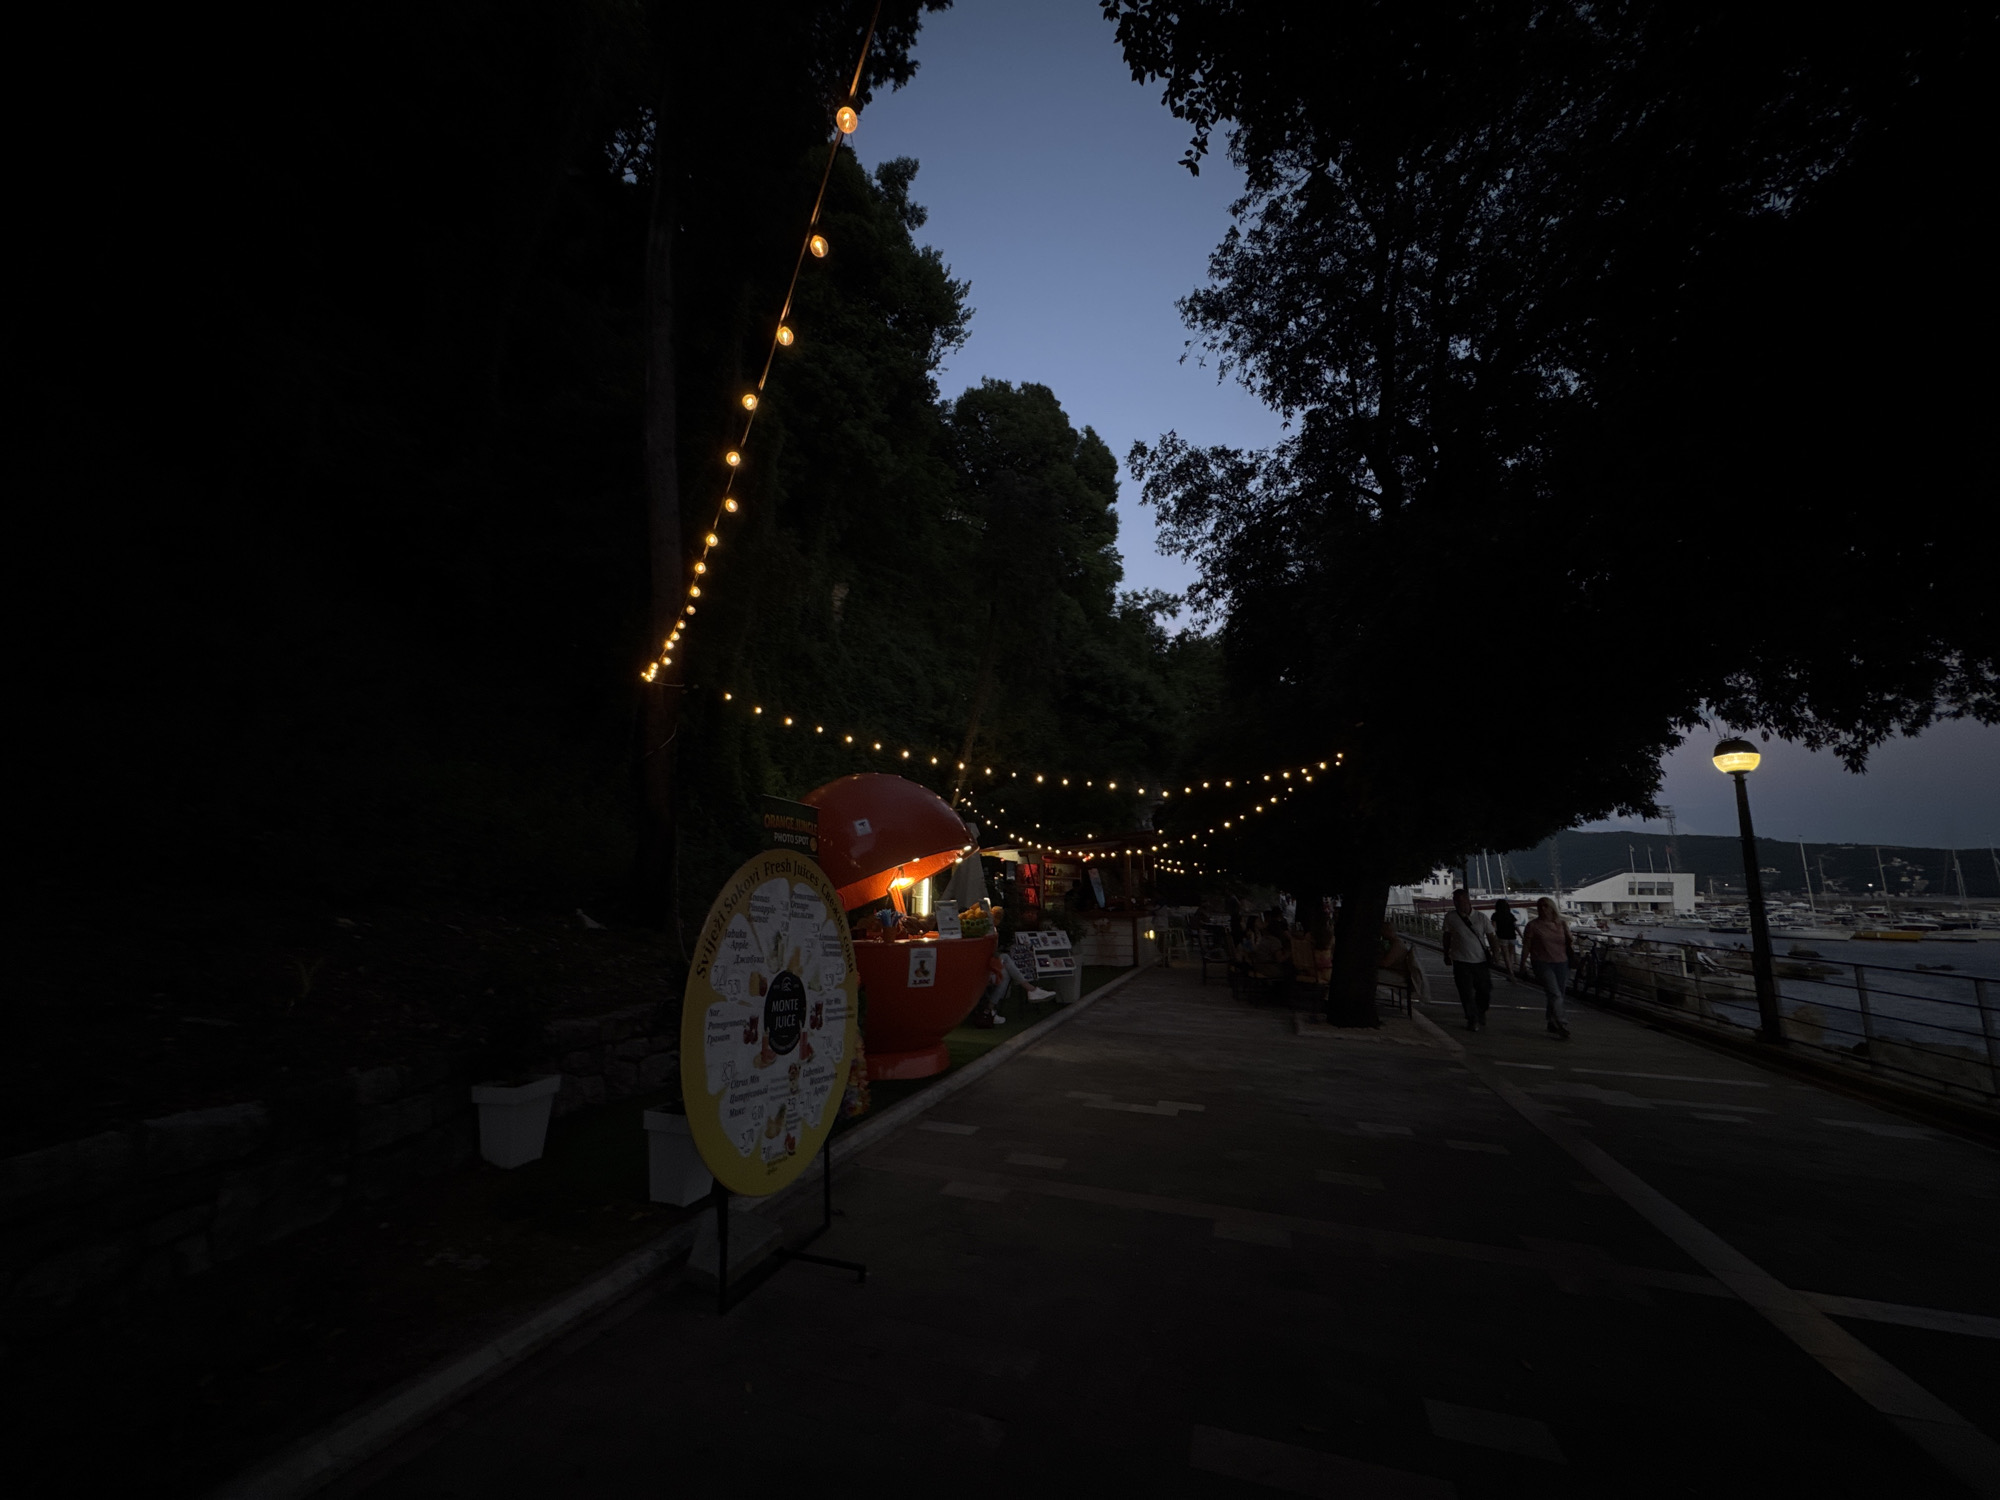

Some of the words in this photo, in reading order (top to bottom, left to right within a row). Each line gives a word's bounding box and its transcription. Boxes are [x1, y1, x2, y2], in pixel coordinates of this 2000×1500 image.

[774, 832, 794, 844] PHOTO
[795, 835, 809, 846] SPOT
[764, 858, 791, 877] Fresh
[793, 860, 819, 886] Juices
[724, 868, 760, 914] Sokovi
[729, 940, 749, 951] Apple
[771, 998, 799, 1013] MONTE
[774, 1015, 796, 1031] JUICE
[730, 1078, 749, 1090] Citrus
[749, 1075, 760, 1085] Mix
